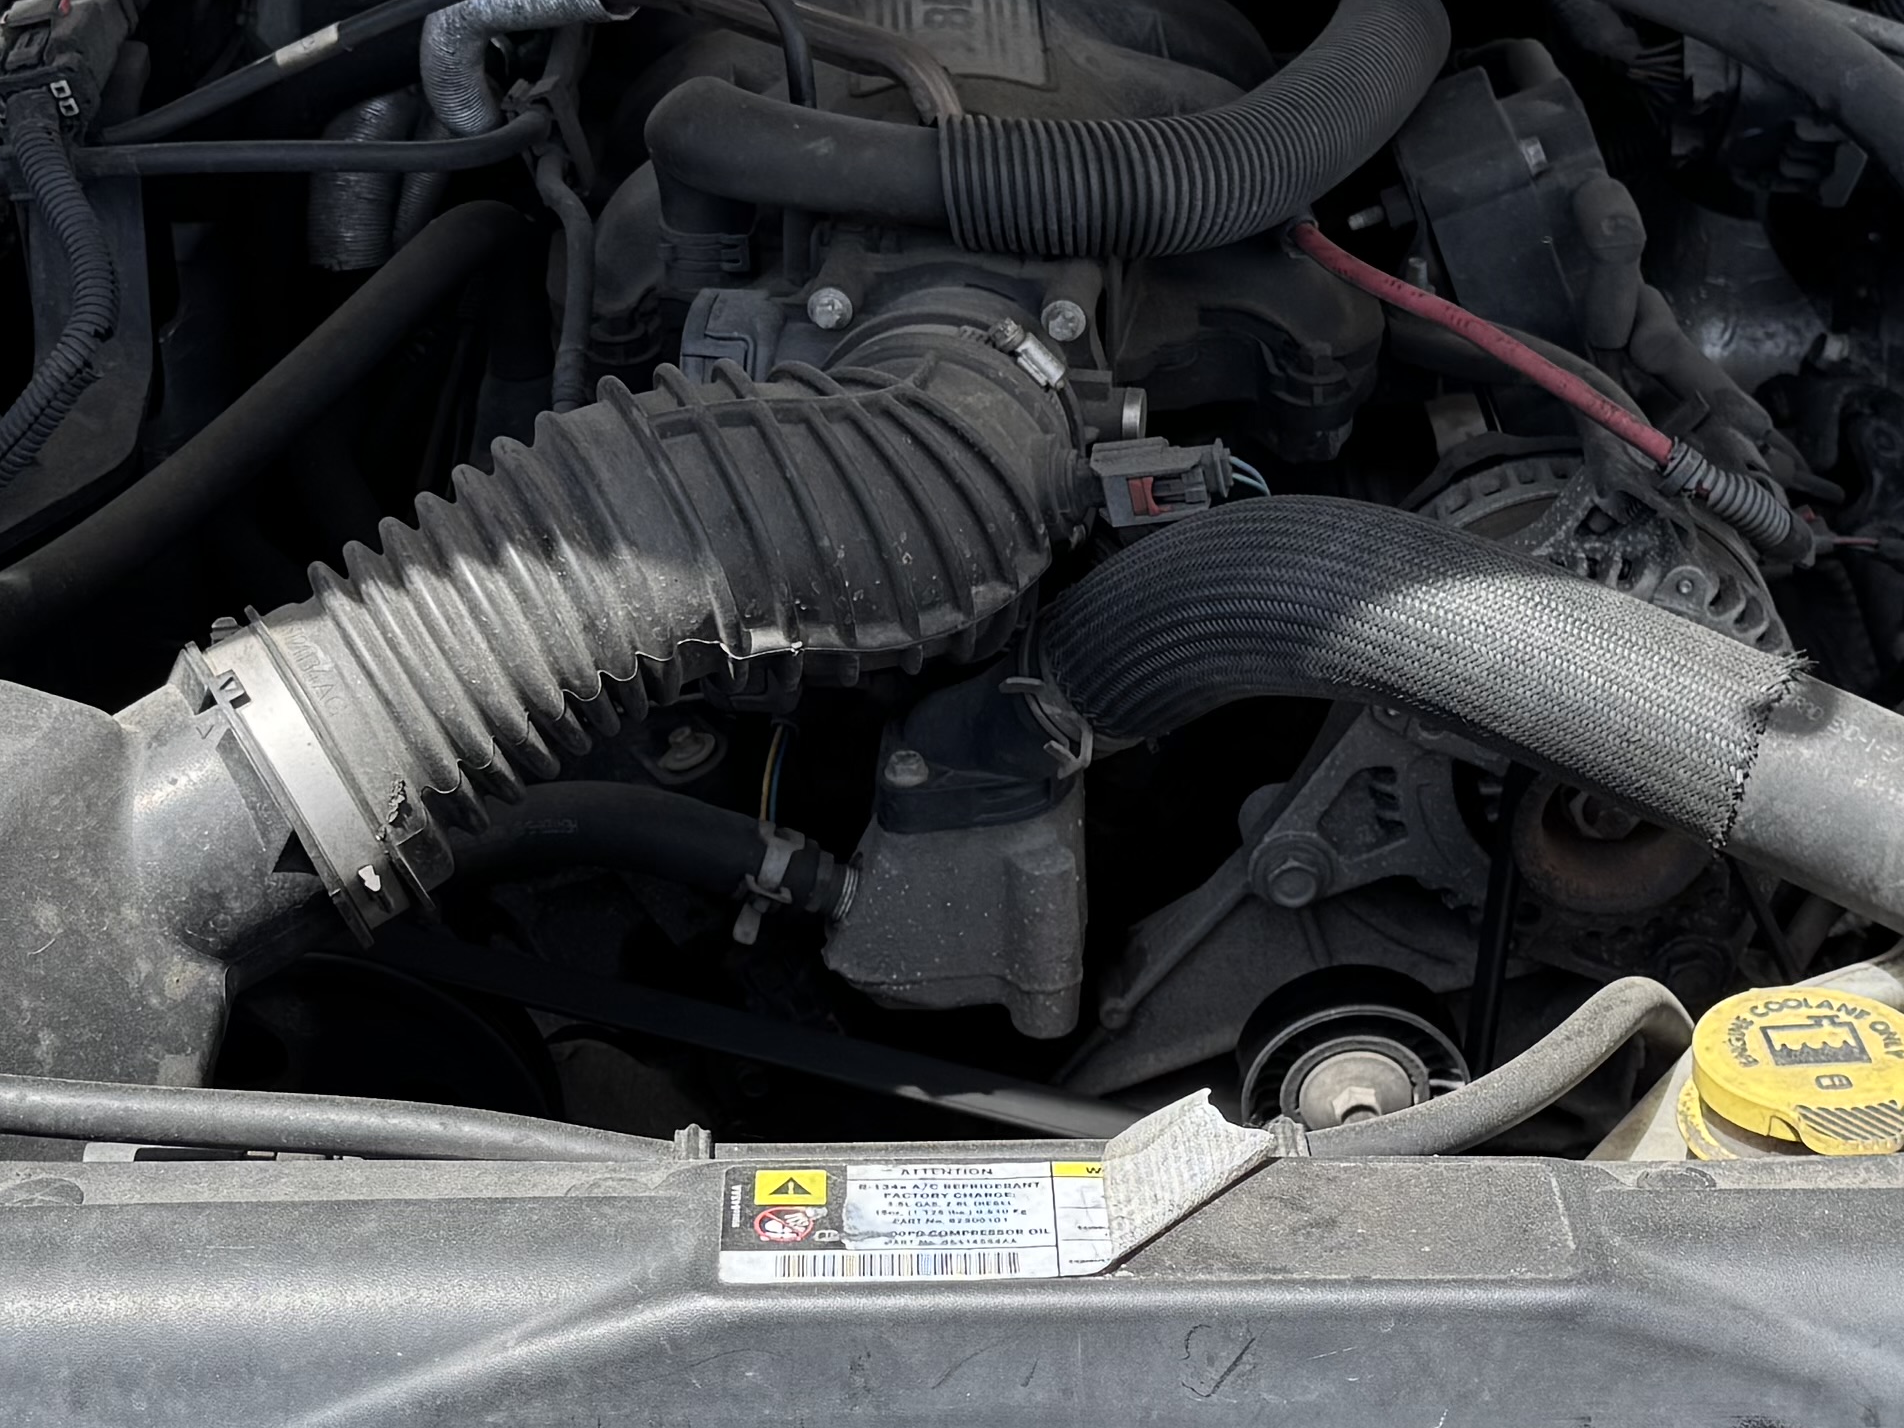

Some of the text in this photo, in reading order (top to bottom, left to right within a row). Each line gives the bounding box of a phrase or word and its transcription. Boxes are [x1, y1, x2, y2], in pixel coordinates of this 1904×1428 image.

[1724, 1015, 1761, 1069] ENGINE
[1750, 995, 1872, 1021] COOLANT
[900, 1167, 994, 1177] ATTENTION
[911, 1181, 938, 1192] A/C
[943, 1180, 1041, 1191] REFRIGERANT
[883, 1192, 949, 1200] FACTORY
[1027, 1227, 1052, 1236] OIL
